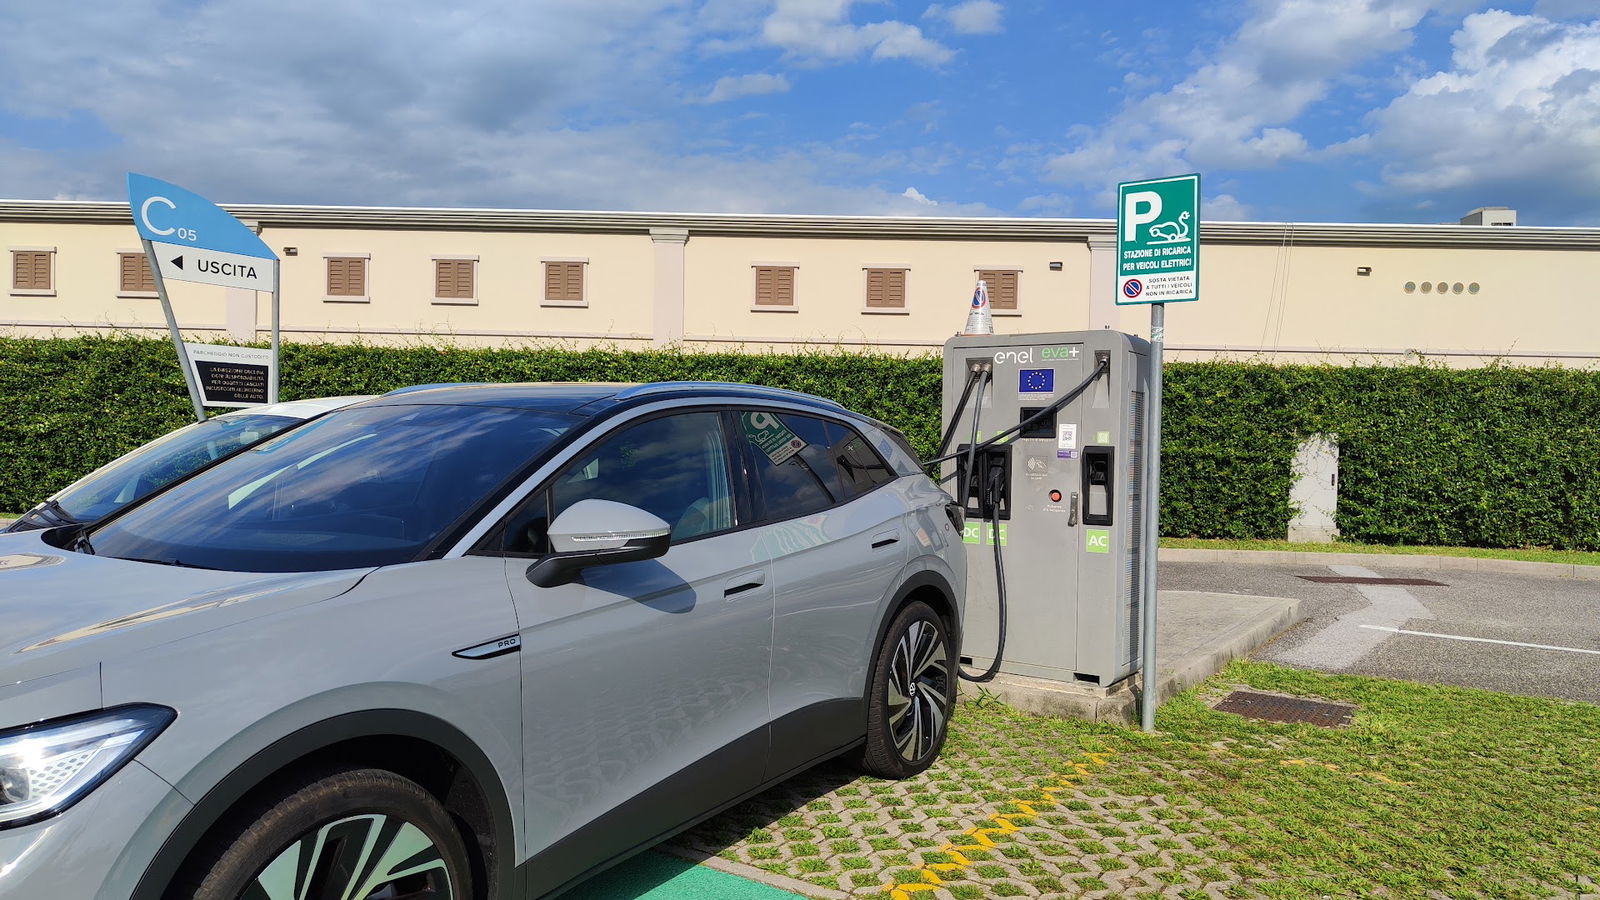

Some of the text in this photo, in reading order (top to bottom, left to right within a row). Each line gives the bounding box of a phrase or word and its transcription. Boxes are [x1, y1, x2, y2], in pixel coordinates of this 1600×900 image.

[141, 196, 197, 241] C 05
[1124, 191, 1162, 242] P
[1123, 246, 1191, 259] STAZIONE DI RICARICA
[197, 259, 258, 280] USCITA
[1122, 258, 1192, 271] PER VEICOLI ELETTRICI
[994, 346, 1080, 365] enel eva+
[963, 527, 979, 538] DC
[1088, 535, 1107, 547] AC
[497, 638, 516, 648] PRO
